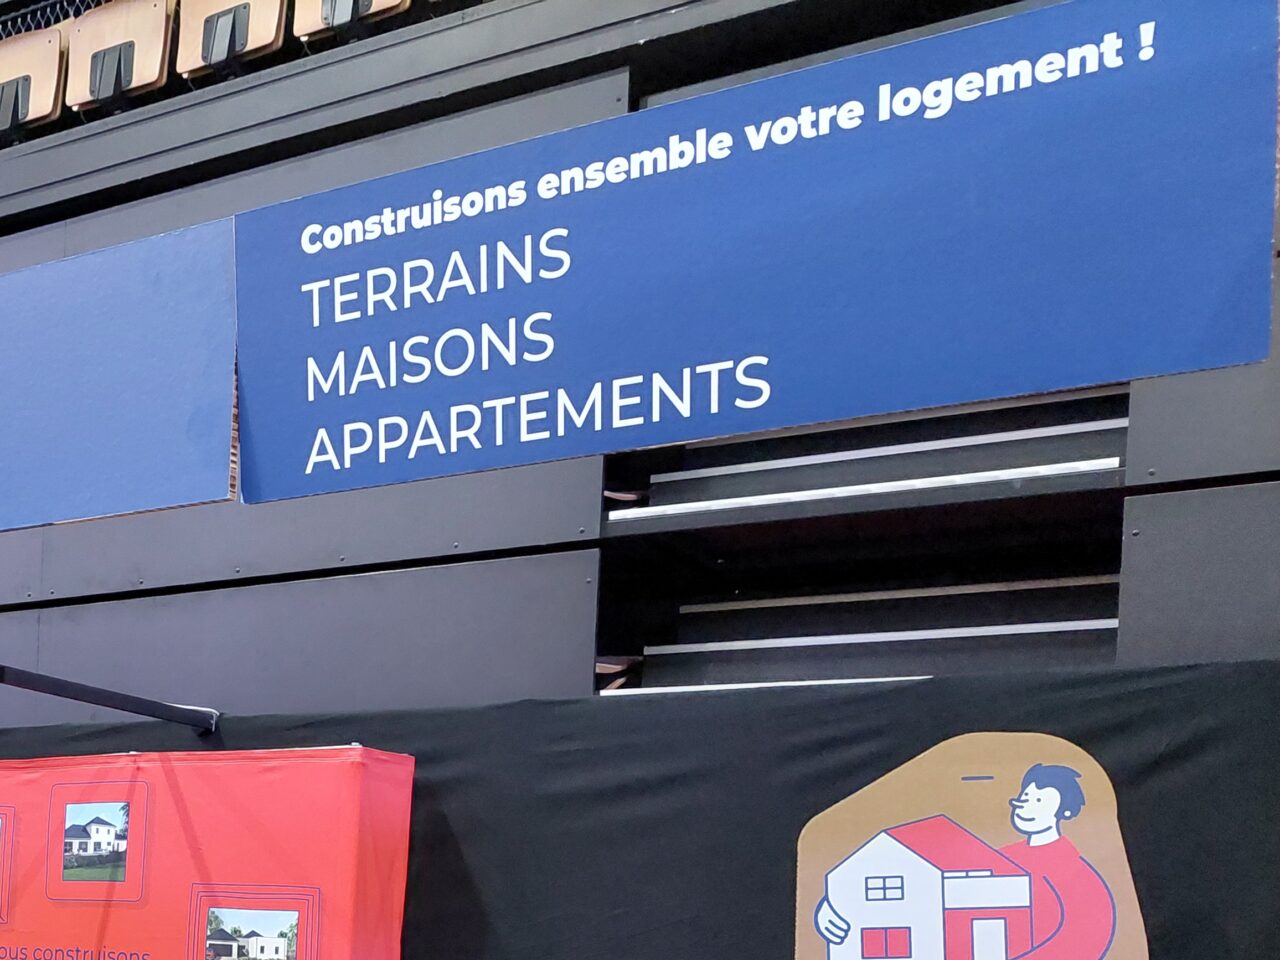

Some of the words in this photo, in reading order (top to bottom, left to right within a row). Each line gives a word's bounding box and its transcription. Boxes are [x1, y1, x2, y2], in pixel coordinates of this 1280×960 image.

[300, 179, 528, 255] Construisons
[536, 127, 733, 200] ensemble
[744, 99, 865, 152] votre
[877, 30, 1125, 121] logement
[1137, 20, 1157, 62] !
[300, 227, 572, 328] TERRAINS
[306, 311, 556, 402] MAISONS
[304, 355, 772, 475] APPARTEMENTS
